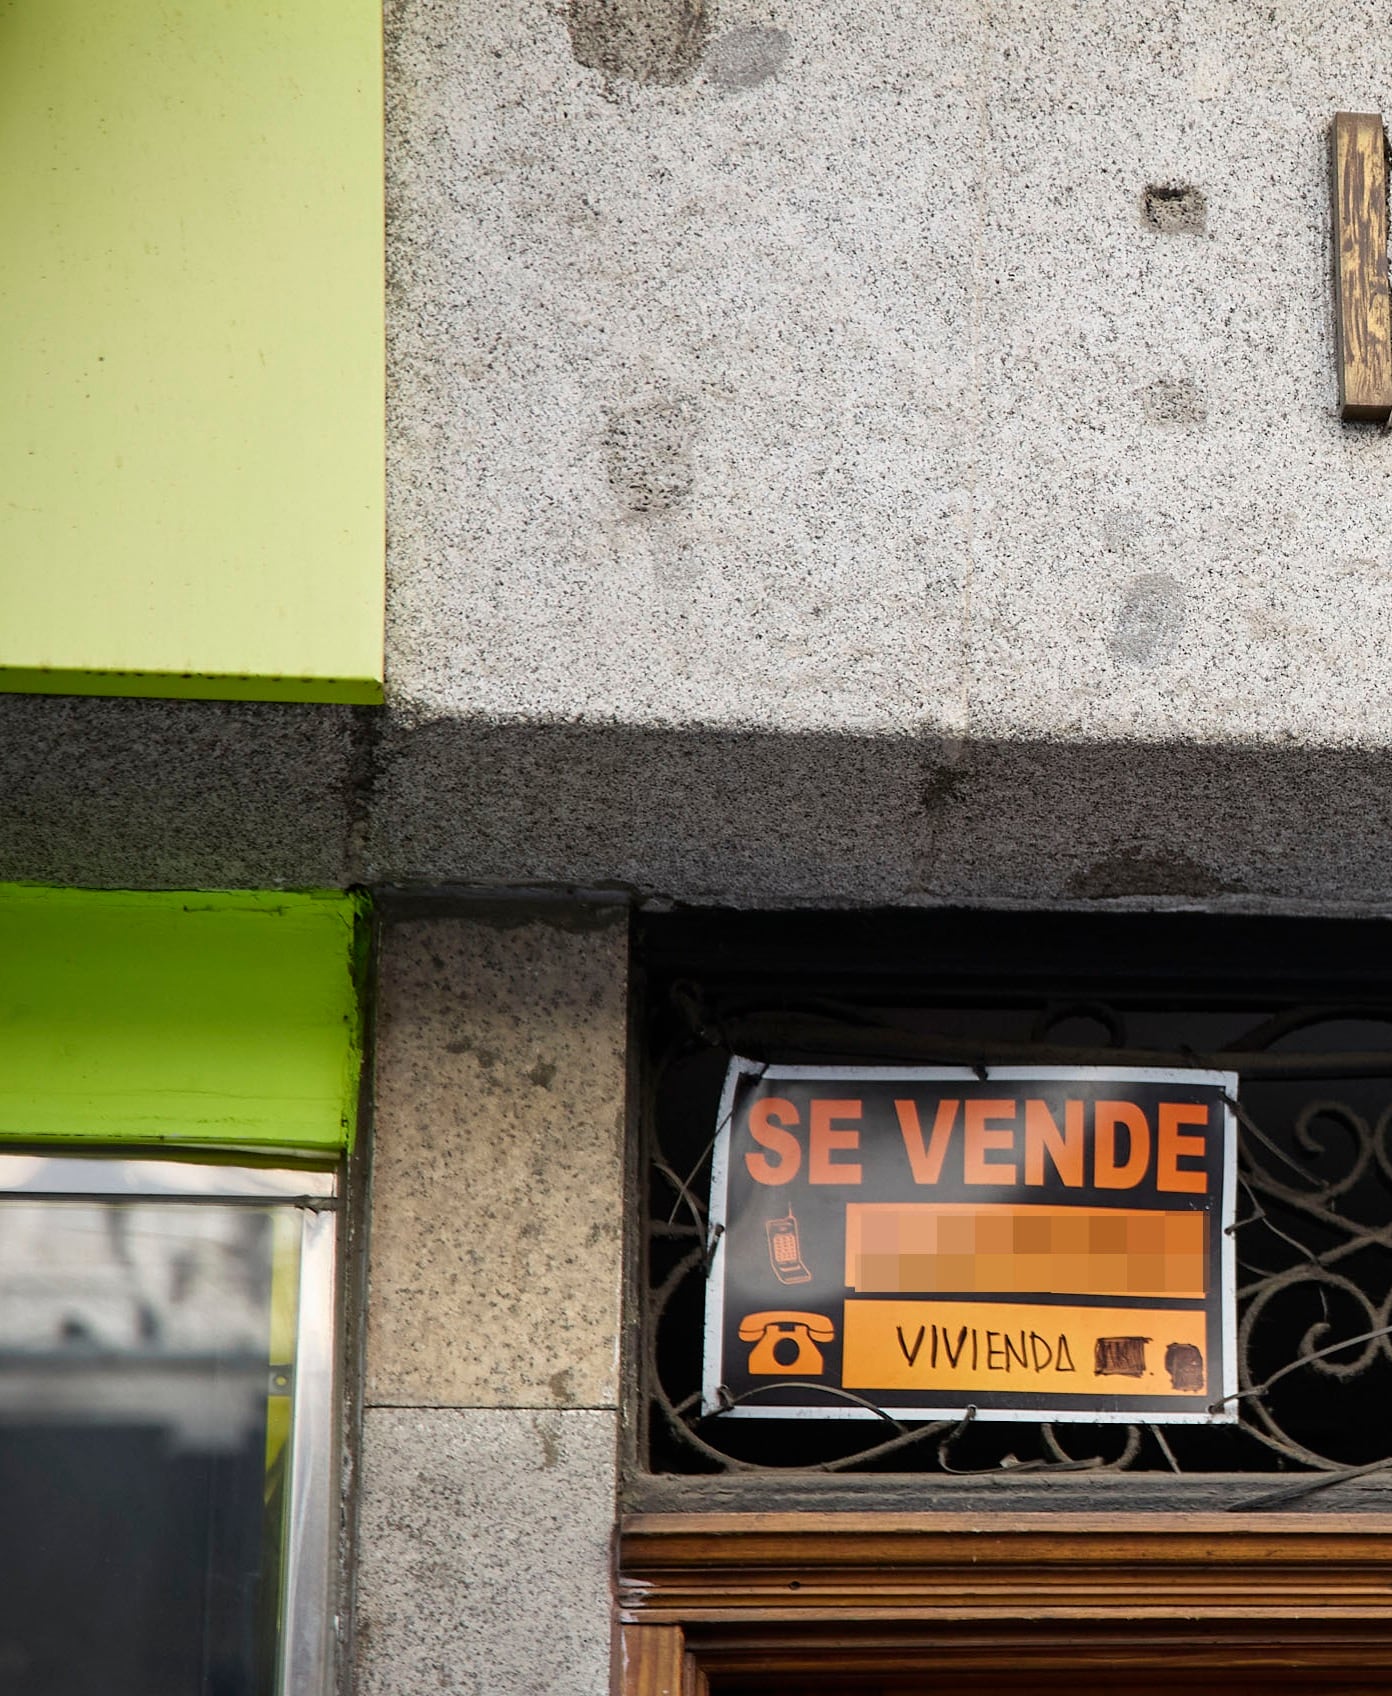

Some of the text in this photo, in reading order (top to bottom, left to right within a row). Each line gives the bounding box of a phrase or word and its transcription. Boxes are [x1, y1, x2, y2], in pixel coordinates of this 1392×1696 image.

[744, 1097, 1209, 1194] SE VENDE
[896, 1324, 1076, 1373] VIVIENDA
